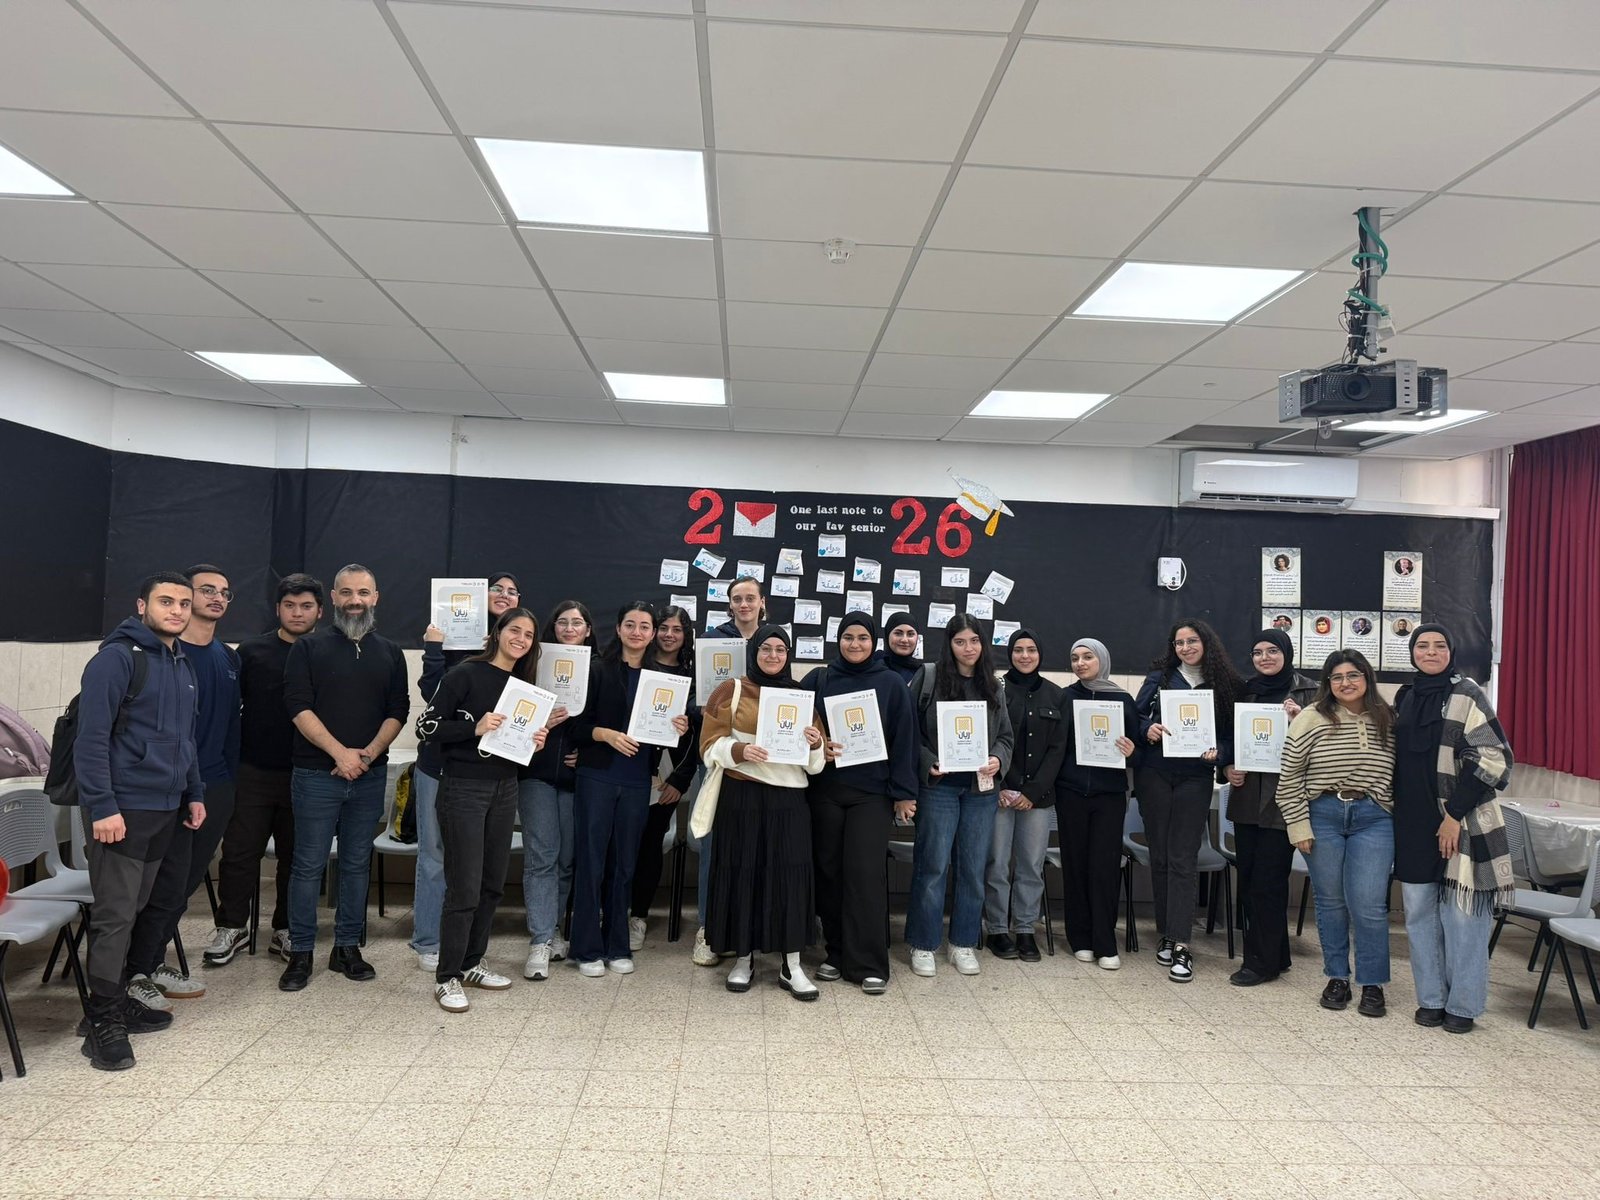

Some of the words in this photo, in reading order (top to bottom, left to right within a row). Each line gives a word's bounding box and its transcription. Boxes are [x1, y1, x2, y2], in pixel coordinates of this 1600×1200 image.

[684, 489, 725, 545] 2
[790, 505, 812, 514] One
[817, 504, 838, 515] last
[841, 505, 866, 515] note
[872, 506, 884, 515] to
[795, 522, 816, 531] our
[826, 520, 844, 531] fav
[850, 522, 886, 533] senior
[890, 497, 973, 558] 26
